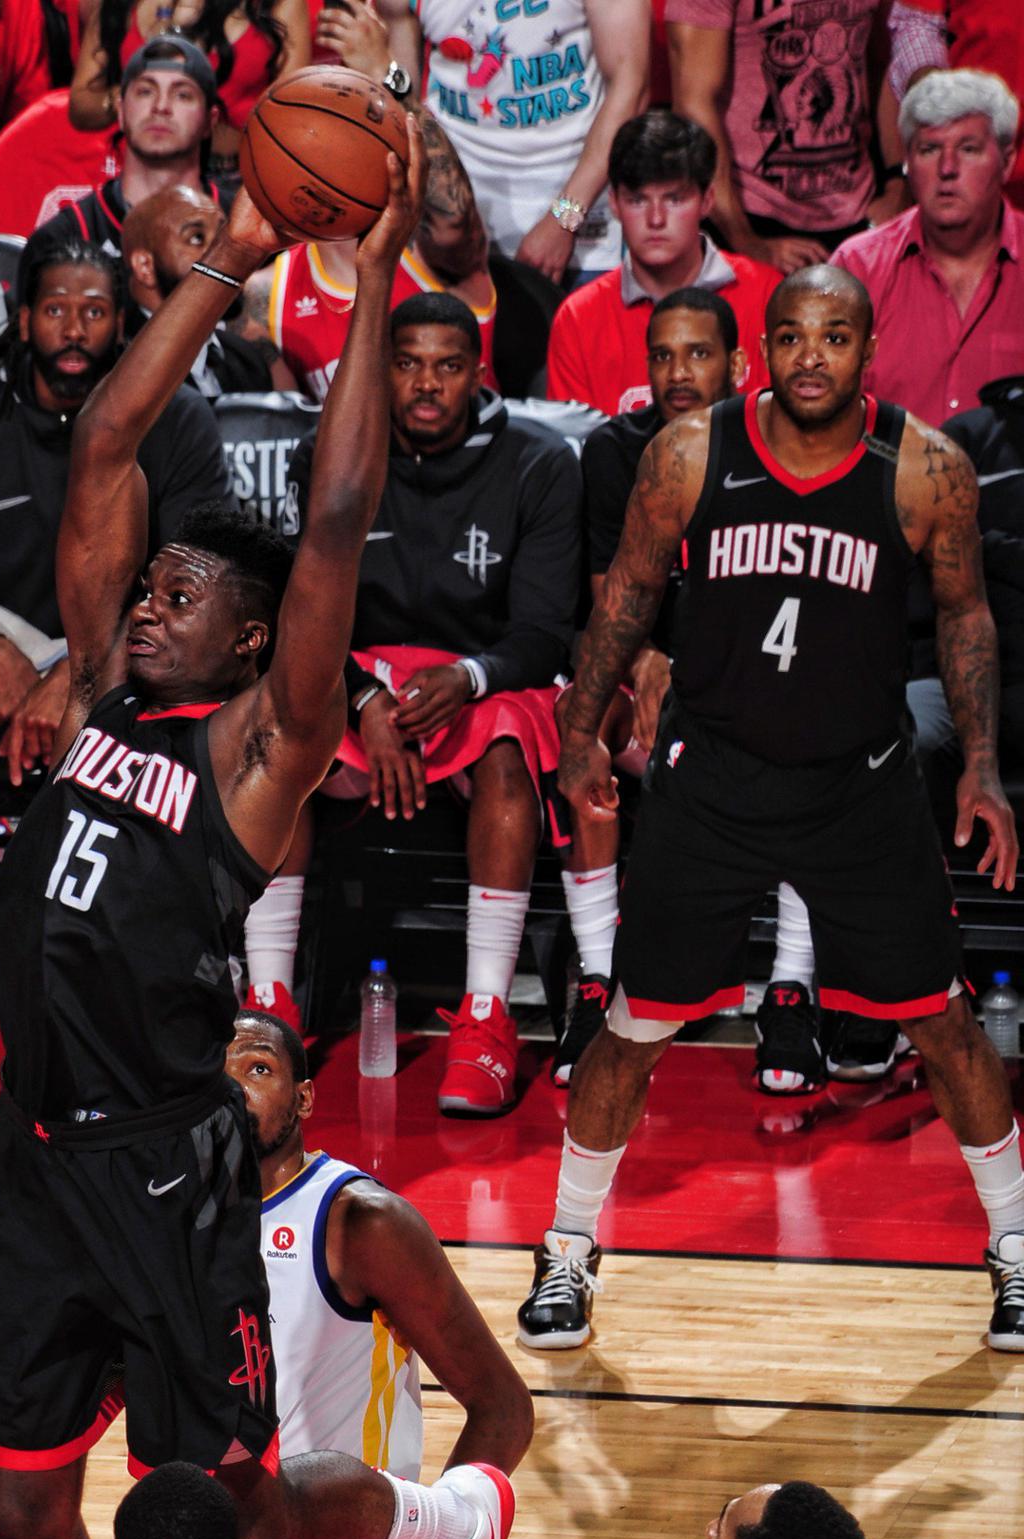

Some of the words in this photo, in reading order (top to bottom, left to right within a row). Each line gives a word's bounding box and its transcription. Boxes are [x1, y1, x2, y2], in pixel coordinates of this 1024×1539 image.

[512, 44, 584, 92] NBA
[498, 79, 591, 129] STARS
[708, 523, 878, 593] HOUSTON
[761, 597, 801, 673] 4
[44, 809, 119, 912] 15
[267, 1250, 297, 1259] Rakuten
